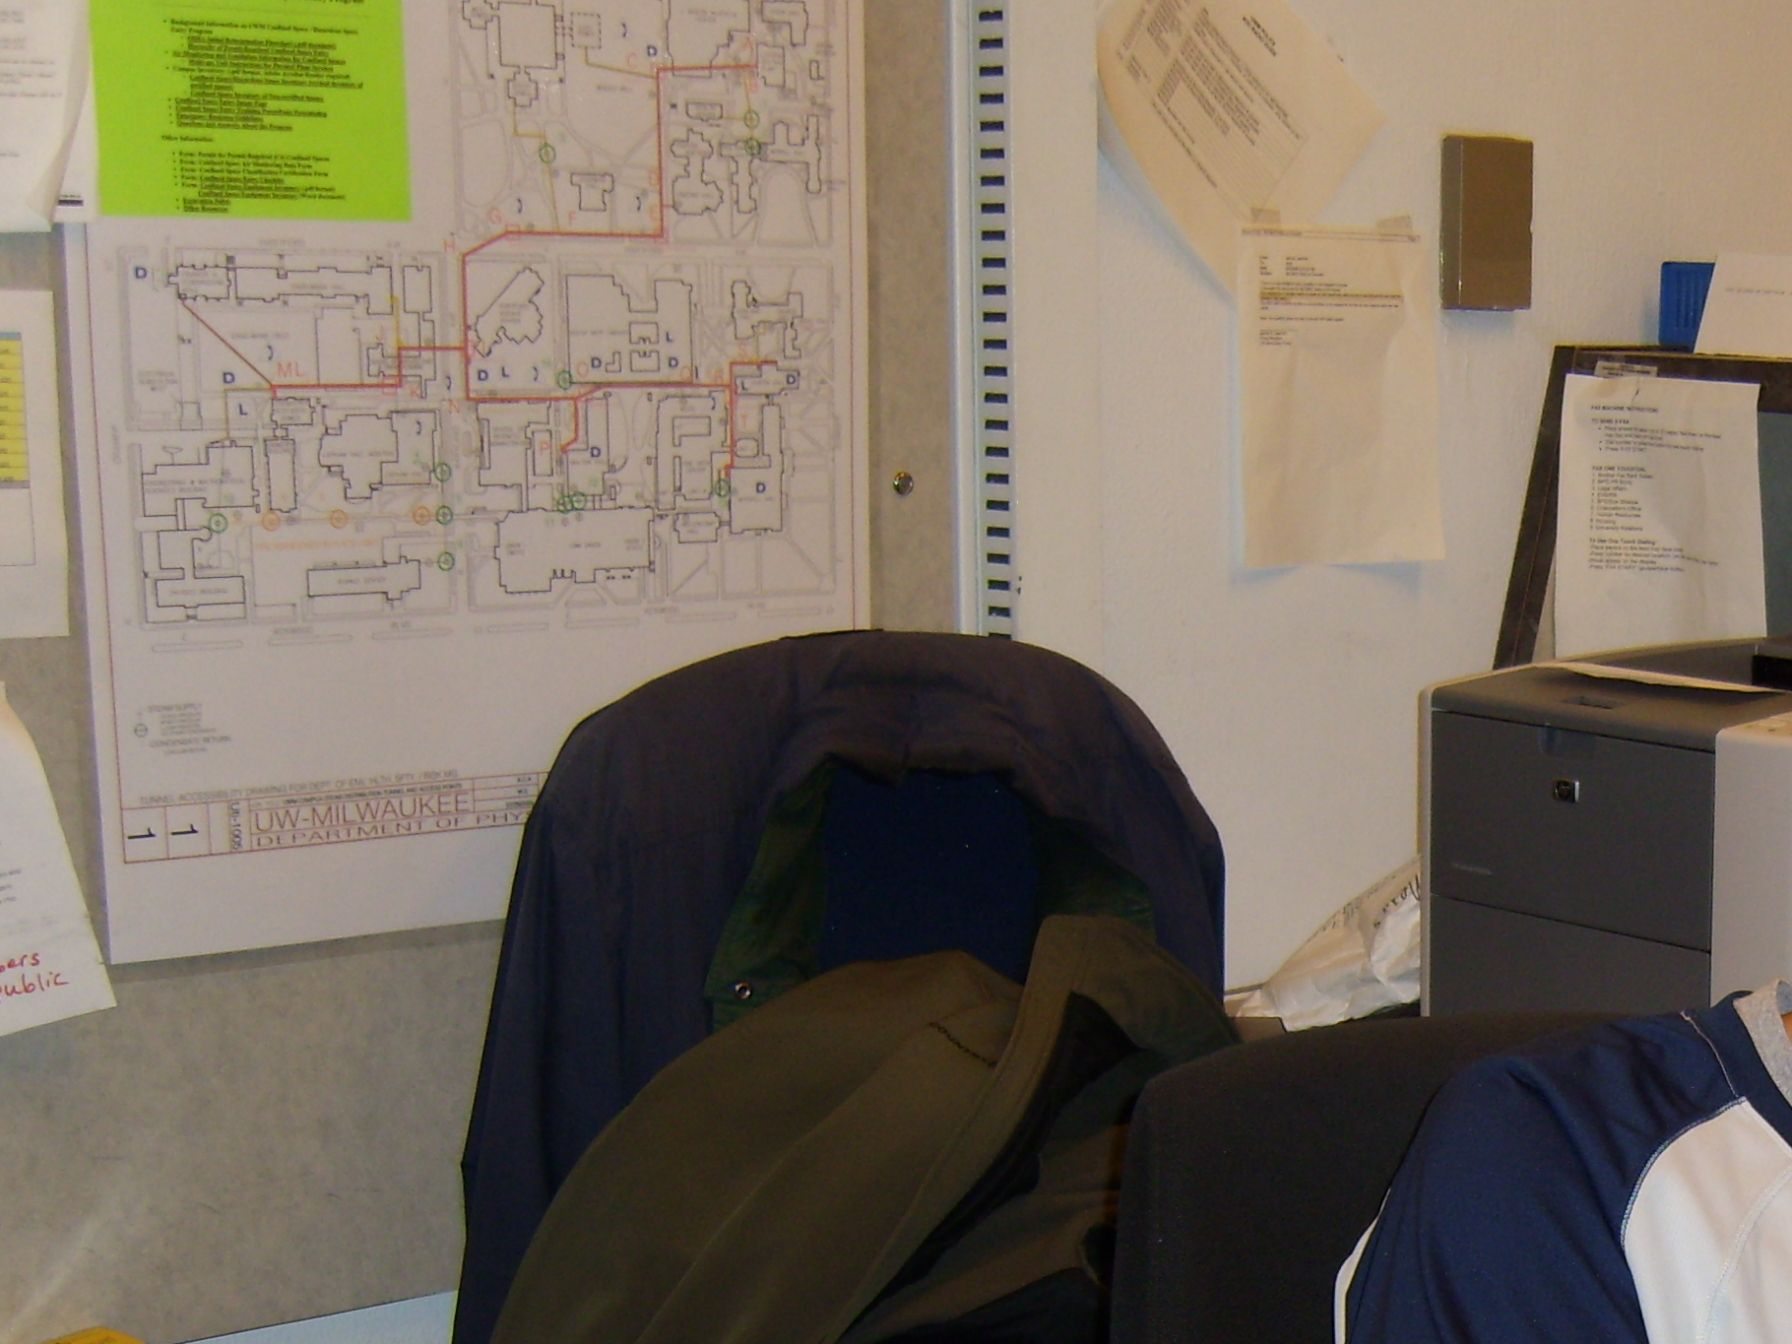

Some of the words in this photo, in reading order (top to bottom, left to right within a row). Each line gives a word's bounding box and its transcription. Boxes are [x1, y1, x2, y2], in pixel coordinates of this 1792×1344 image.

[255, 790, 470, 833] UW-MILWAUKEE
[256, 819, 424, 847] DEPARTMENT
[435, 817, 464, 829] OF
[0, 971, 69, 997] ublic
